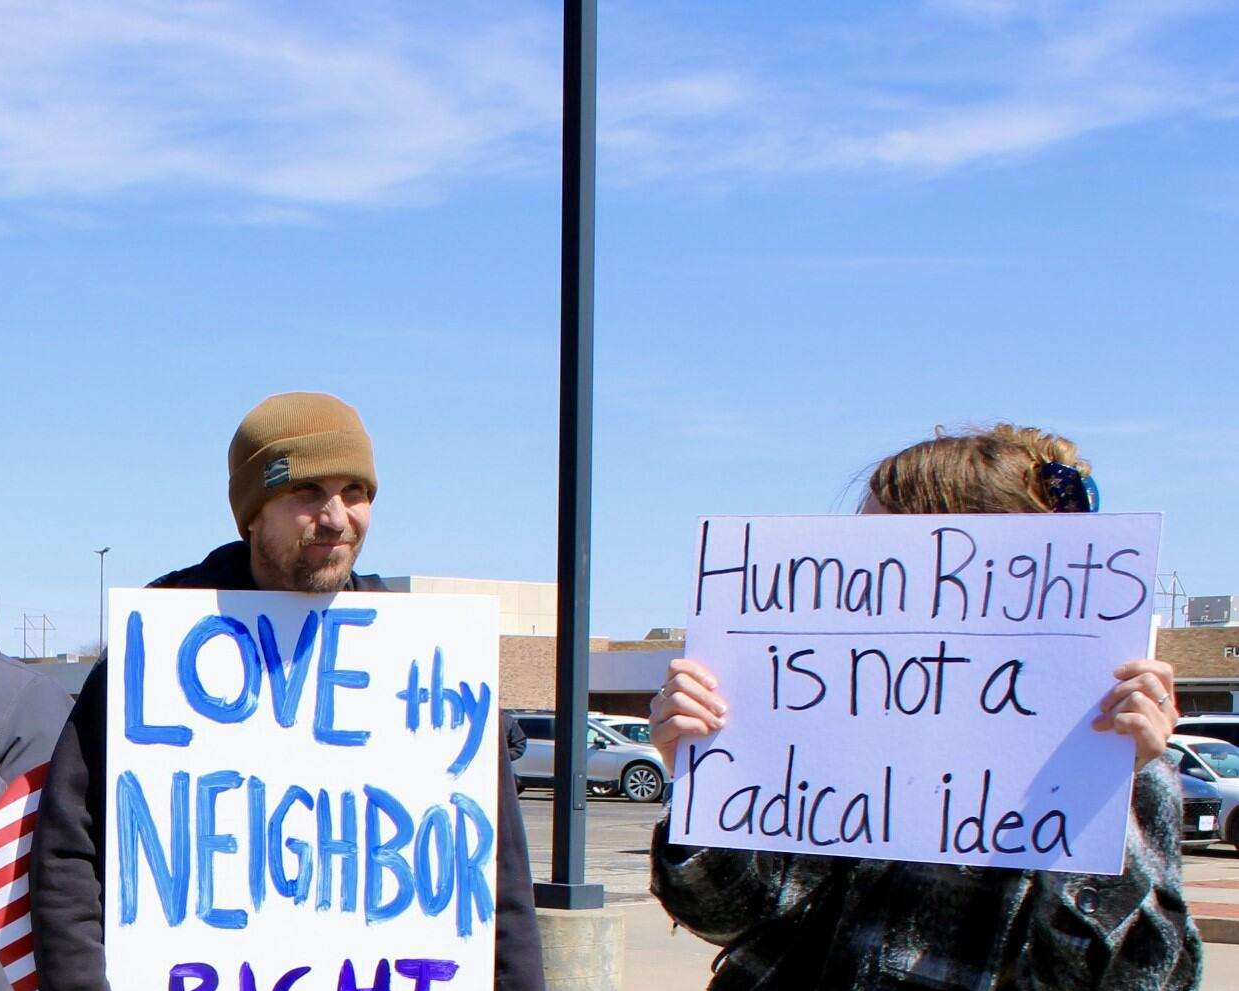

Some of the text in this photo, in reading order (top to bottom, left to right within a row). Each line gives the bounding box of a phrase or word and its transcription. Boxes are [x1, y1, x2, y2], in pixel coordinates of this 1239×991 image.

[695, 520, 1147, 621] Human Rights
[124, 608, 492, 780] LOVE thy
[767, 640, 1037, 717] is not a
[117, 769, 495, 939] NEIGHBOR
[684, 744, 1073, 858] radical idea
